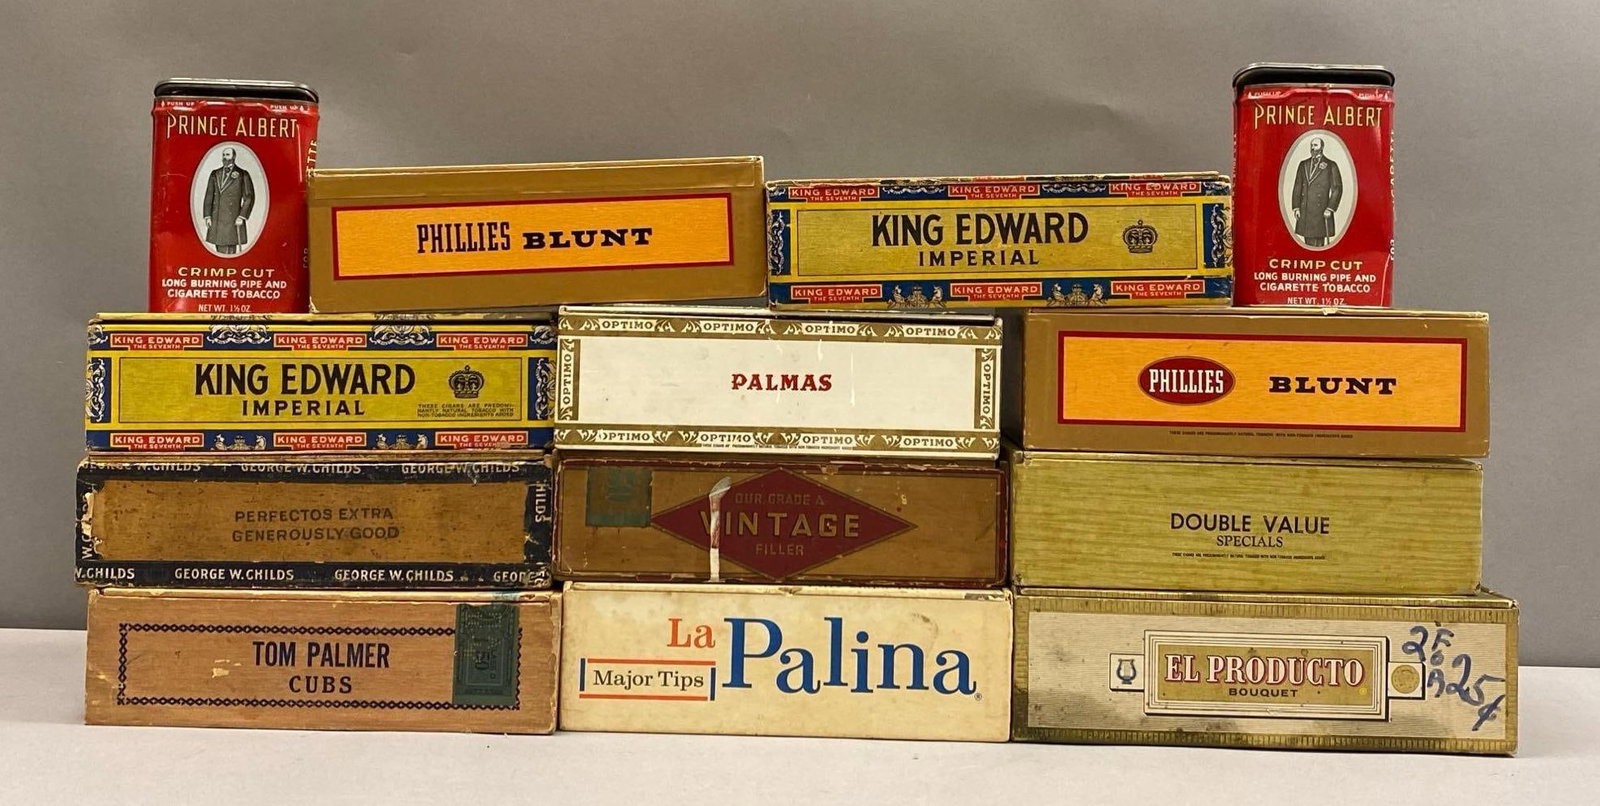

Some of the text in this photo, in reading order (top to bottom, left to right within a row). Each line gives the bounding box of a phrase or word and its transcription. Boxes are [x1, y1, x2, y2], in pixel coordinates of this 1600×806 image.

[1254, 101, 1383, 130] PRINCE ALBERT
[167, 111, 297, 139] PRINCE ALBERT
[791, 187, 876, 197] KING EDWARD
[951, 185, 1036, 194] KING EDWARD
[1112, 182, 1197, 191] KING EDWARD
[871, 212, 1089, 247] KING EDWARD
[416, 221, 653, 255] PHILLIES BLUNT
[918, 250, 1040, 267] IMPERIAL
[1269, 258, 1363, 270] CRIMP CUT
[178, 266, 275, 278] CRIMP CUT
[1254, 272, 1376, 282] LONG BURNING PIPE AND
[162, 278, 287, 289] LONG BURNING PIPE AND
[954, 285, 1038, 294] KING EDWARD
[1116, 283, 1201, 292] KING EDWARD
[1260, 282, 1371, 293] CIGARETTE TOBACCO
[167, 289, 280, 299] CIGARETTE TOBACCO
[794, 288, 879, 297] KING EDWARD
[1287, 297, 1303, 305] NET
[198, 304, 212, 313] NET
[602, 320, 653, 330] OPTIMO
[704, 322, 755, 332] OPTIMO
[805, 325, 856, 334] OPTIMO
[906, 327, 956, 337] OPTIMO
[114, 336, 200, 344] KING EDWARD
[278, 336, 364, 344] KING EDWARD
[440, 336, 525, 344] KING EDWARD
[195, 363, 416, 396] KING EDWARD
[563, 353, 572, 405] OPTIMO
[731, 374, 832, 391] PALMAS
[1148, 368, 1397, 395] PHILLIES BLUNT
[982, 363, 992, 414] OPTIMO
[242, 399, 367, 417] IMPERIAL
[115, 436, 201, 444] KING EDWARD
[278, 436, 363, 444] KING EDWARD
[440, 434, 525, 443] KING EDWARD
[701, 434, 751, 443] OPTIMO
[802, 435, 853, 445] OPTIMO
[903, 438, 954, 447] OPTIMO
[401, 465, 451, 475] GEORGE
[535, 483, 547, 523] HILDS
[735, 493, 763, 505] OUR
[768, 493, 811, 505] GRADE
[235, 508, 394, 523] PERFECTOS EXTRA
[699, 510, 860, 538] VINTAGE
[1170, 513, 1330, 535] DOUBLE VALUE
[232, 526, 400, 543] GENEROUSLY GOOD
[1216, 535, 1284, 548] SPECIALS
[755, 543, 804, 556] FILLER
[174, 568, 226, 580] GEORGE
[334, 569, 385, 582] GEORGE
[666, 618, 716, 649] La
[1402, 626, 1429, 662] 2
[252, 641, 390, 669] TOM PALMER
[722, 617, 978, 695] Palina
[1164, 654, 1365, 687] EL PRODUCTO
[288, 676, 353, 695] CUBS
[592, 670, 705, 691] Major Tips
[1228, 688, 1299, 698] BOUQUET
